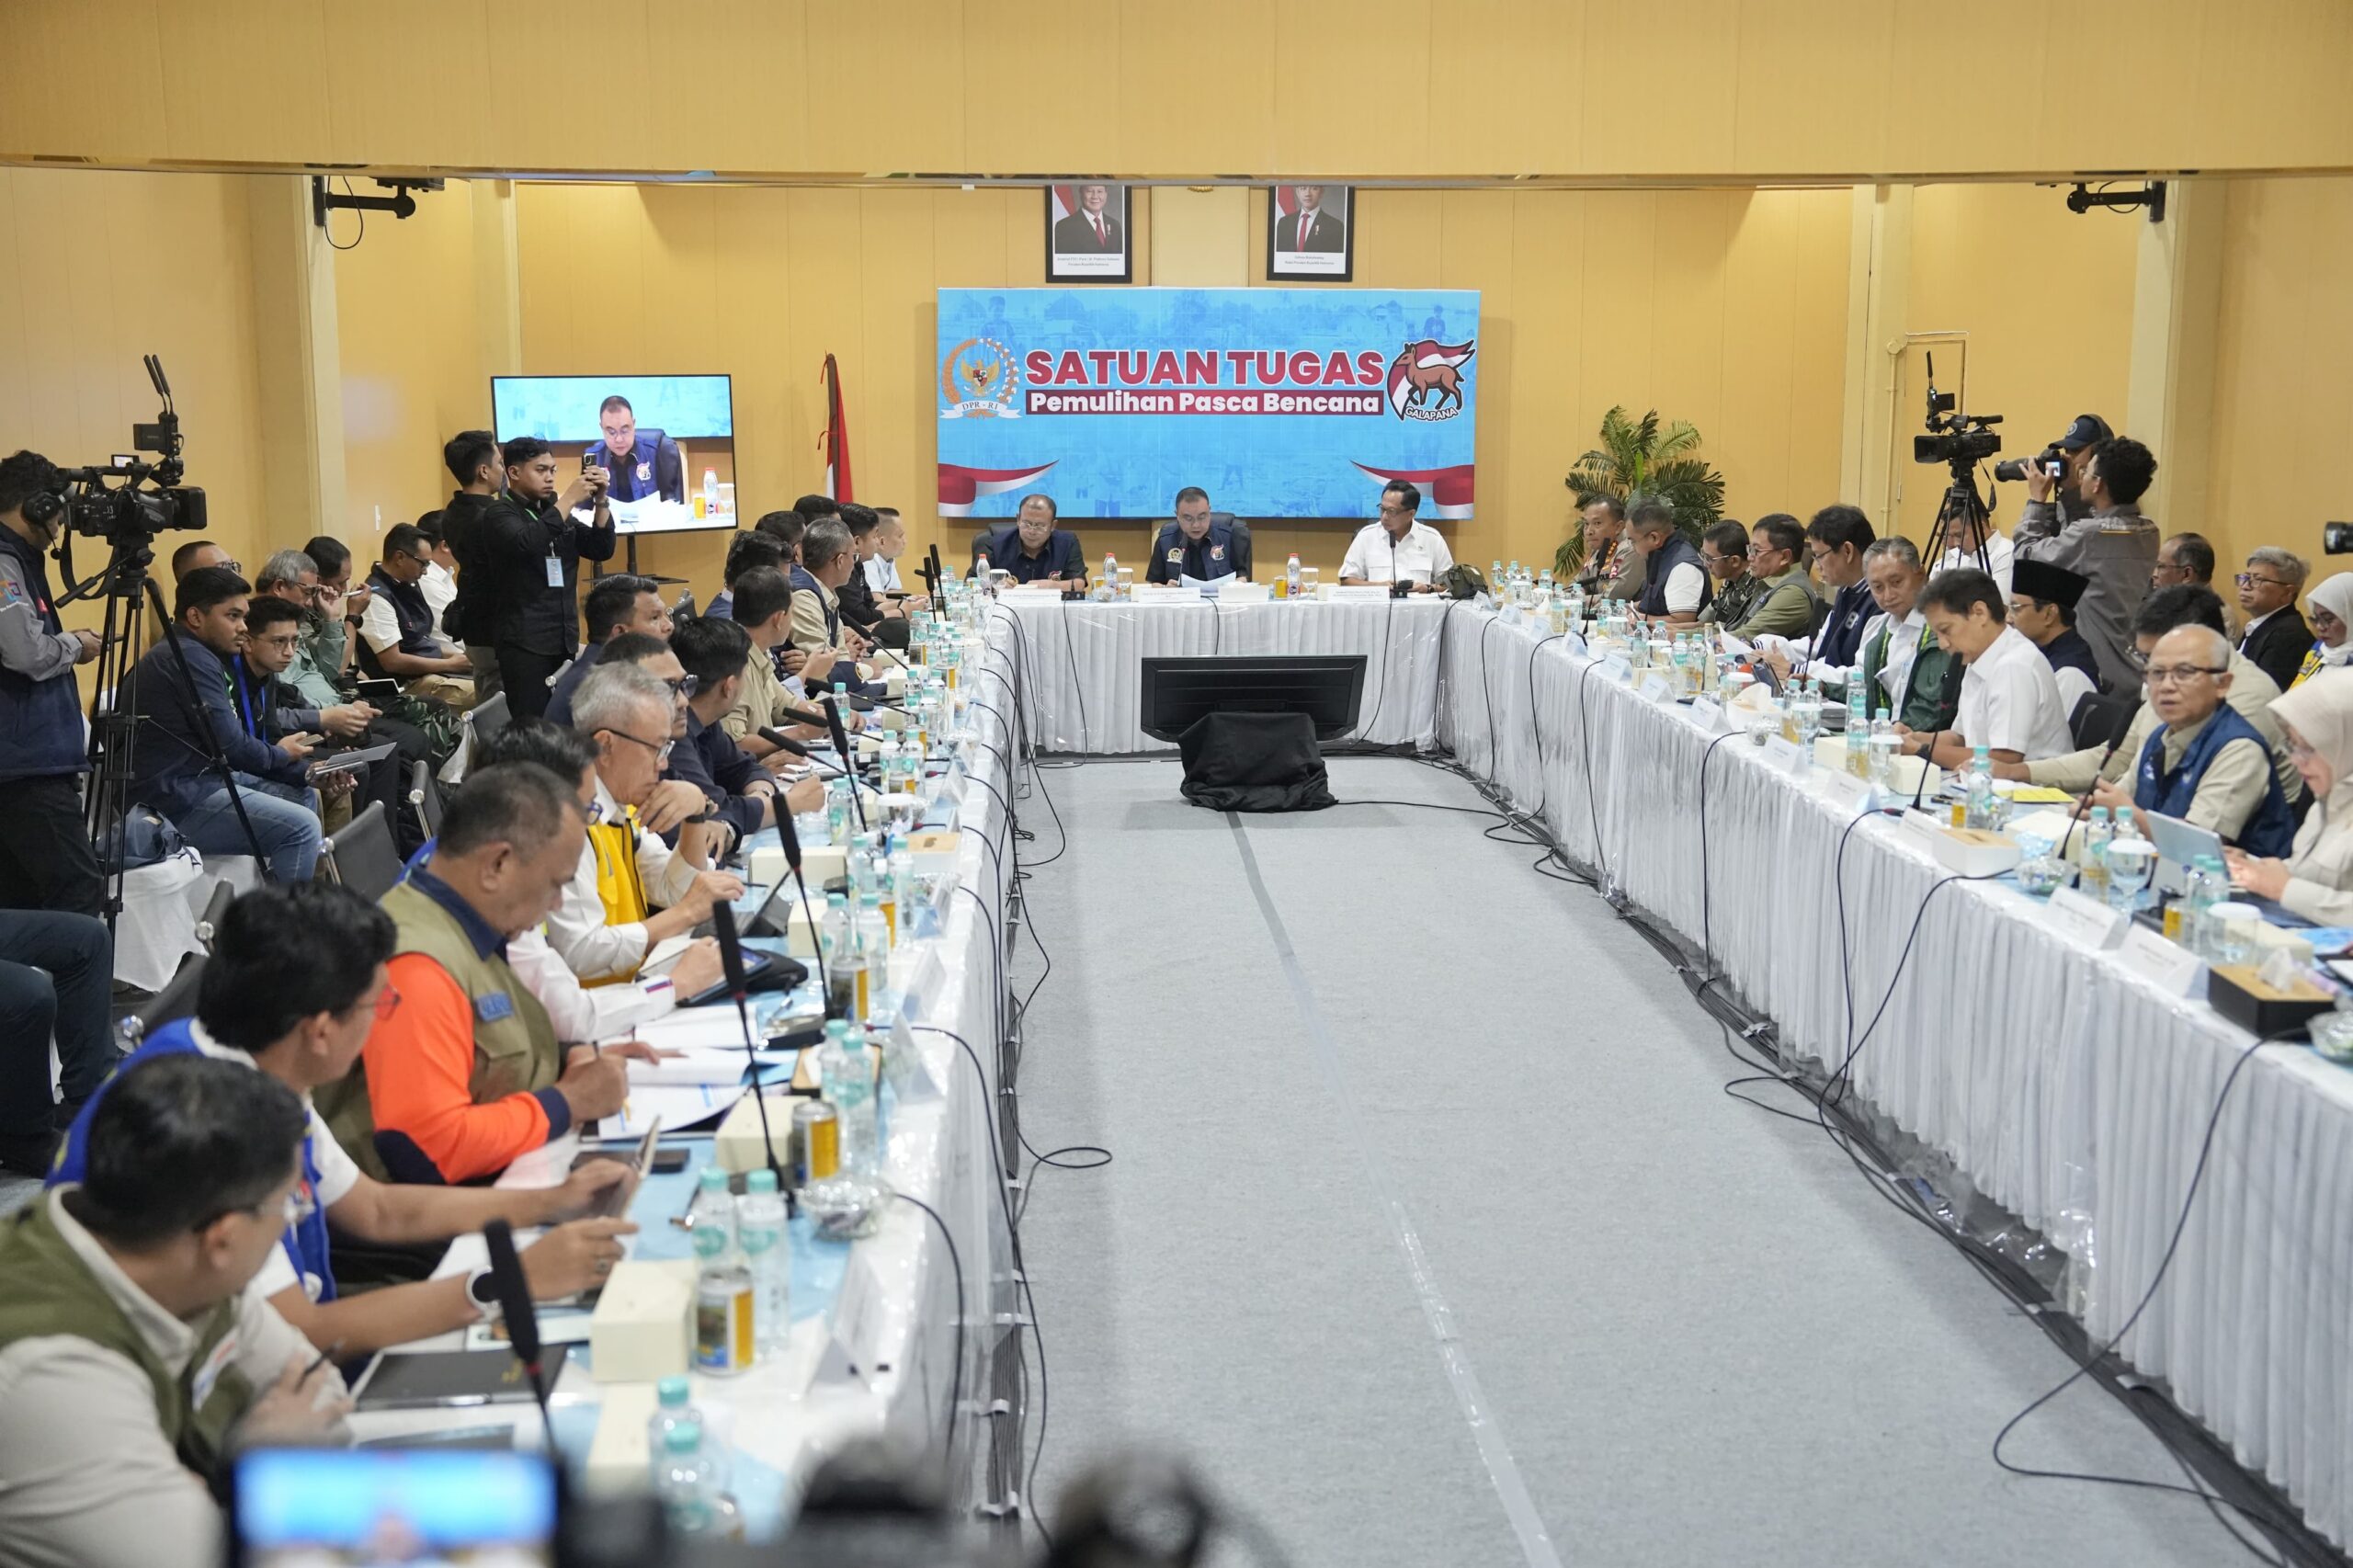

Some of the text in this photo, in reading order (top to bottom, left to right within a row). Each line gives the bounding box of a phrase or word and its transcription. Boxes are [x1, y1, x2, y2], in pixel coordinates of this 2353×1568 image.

[1025, 349, 1385, 386] SATUAN TUGAS
[961, 402, 980, 410] DPR
[987, 402, 998, 410] RI
[1030, 390, 1379, 412] Pemulihan Pasca Bencana
[1404, 406, 1458, 420] GALAPANA
